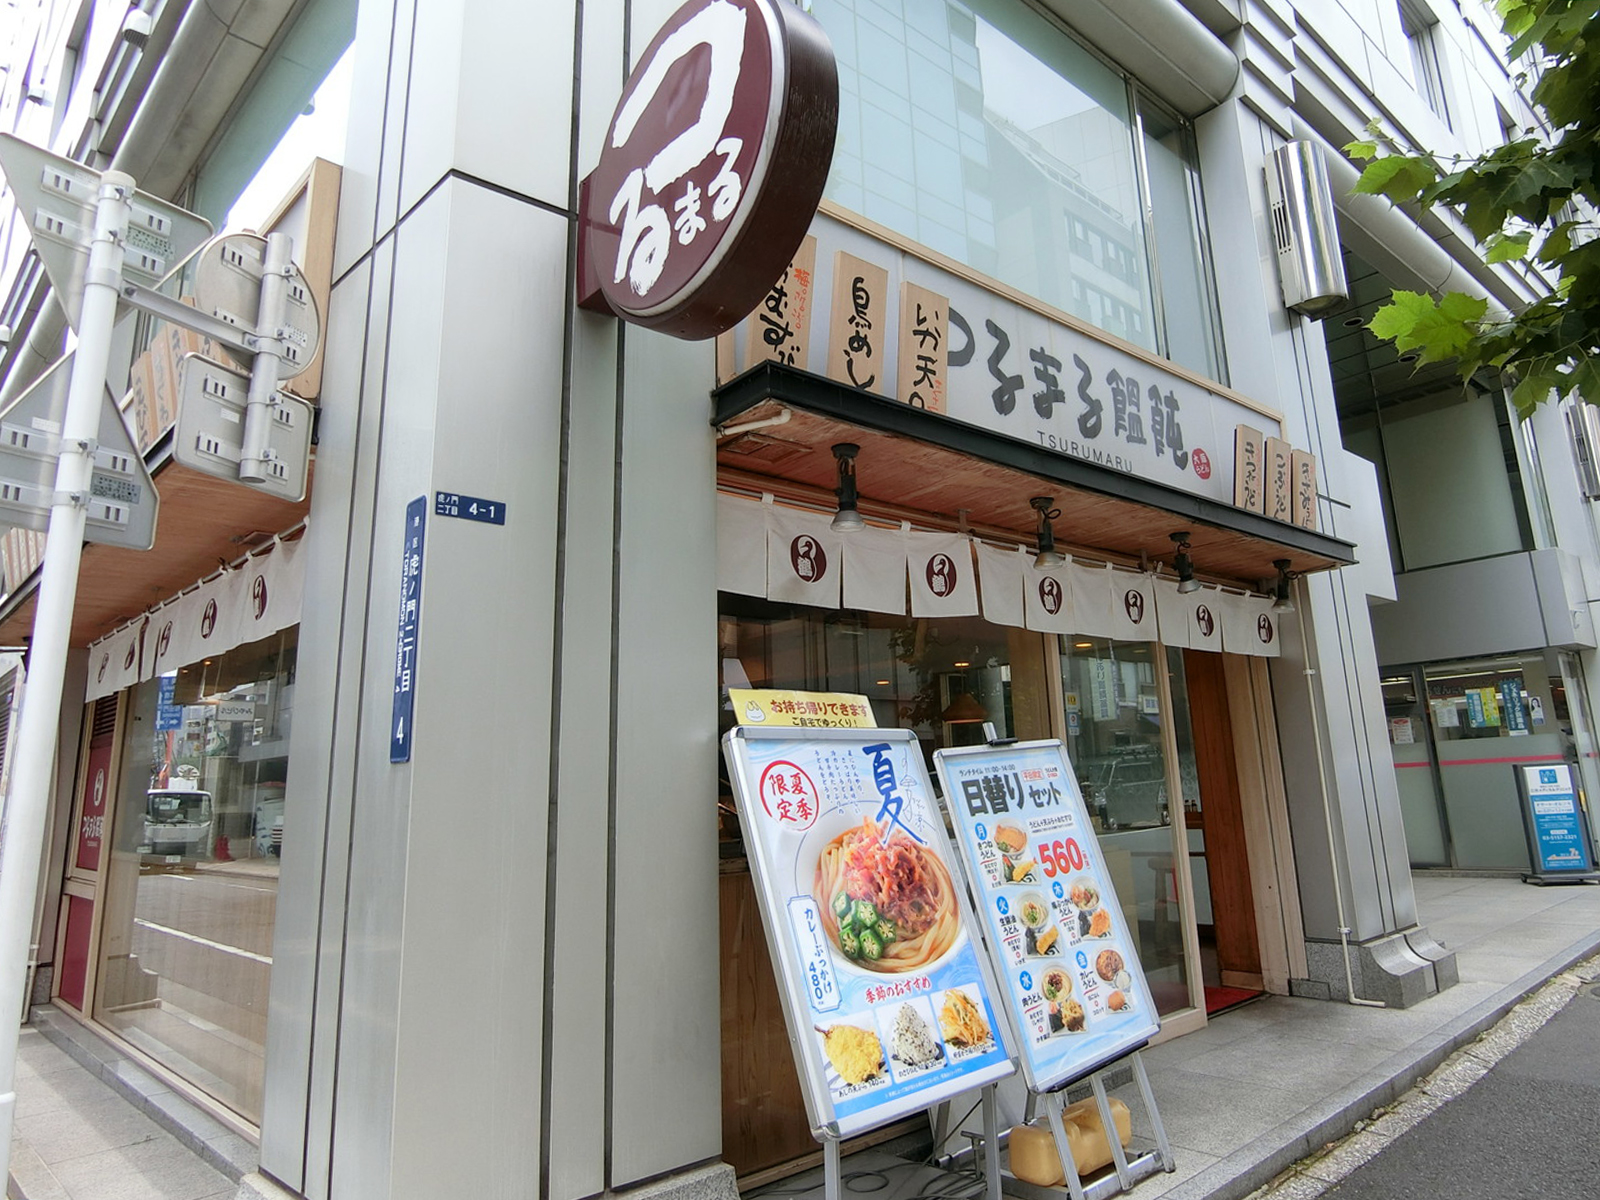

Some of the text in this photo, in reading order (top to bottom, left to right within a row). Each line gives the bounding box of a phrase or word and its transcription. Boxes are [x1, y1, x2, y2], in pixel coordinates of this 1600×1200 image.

[1037, 430, 1133, 473] TSURUMARU
[437, 504, 458, 515] 二丁目
[438, 494, 459, 505] 虎ノ門
[469, 502, 495, 518] 4-1
[770, 699, 867, 717] お持ち帰りできます
[396, 716, 404, 744] 4
[862, 743, 928, 846] 夏
[1038, 837, 1083, 878] 560
[804, 908, 832, 993] カレーぶっかけ
[809, 961, 823, 999] 480
[866, 976, 930, 1004] 季節のおすすめ
